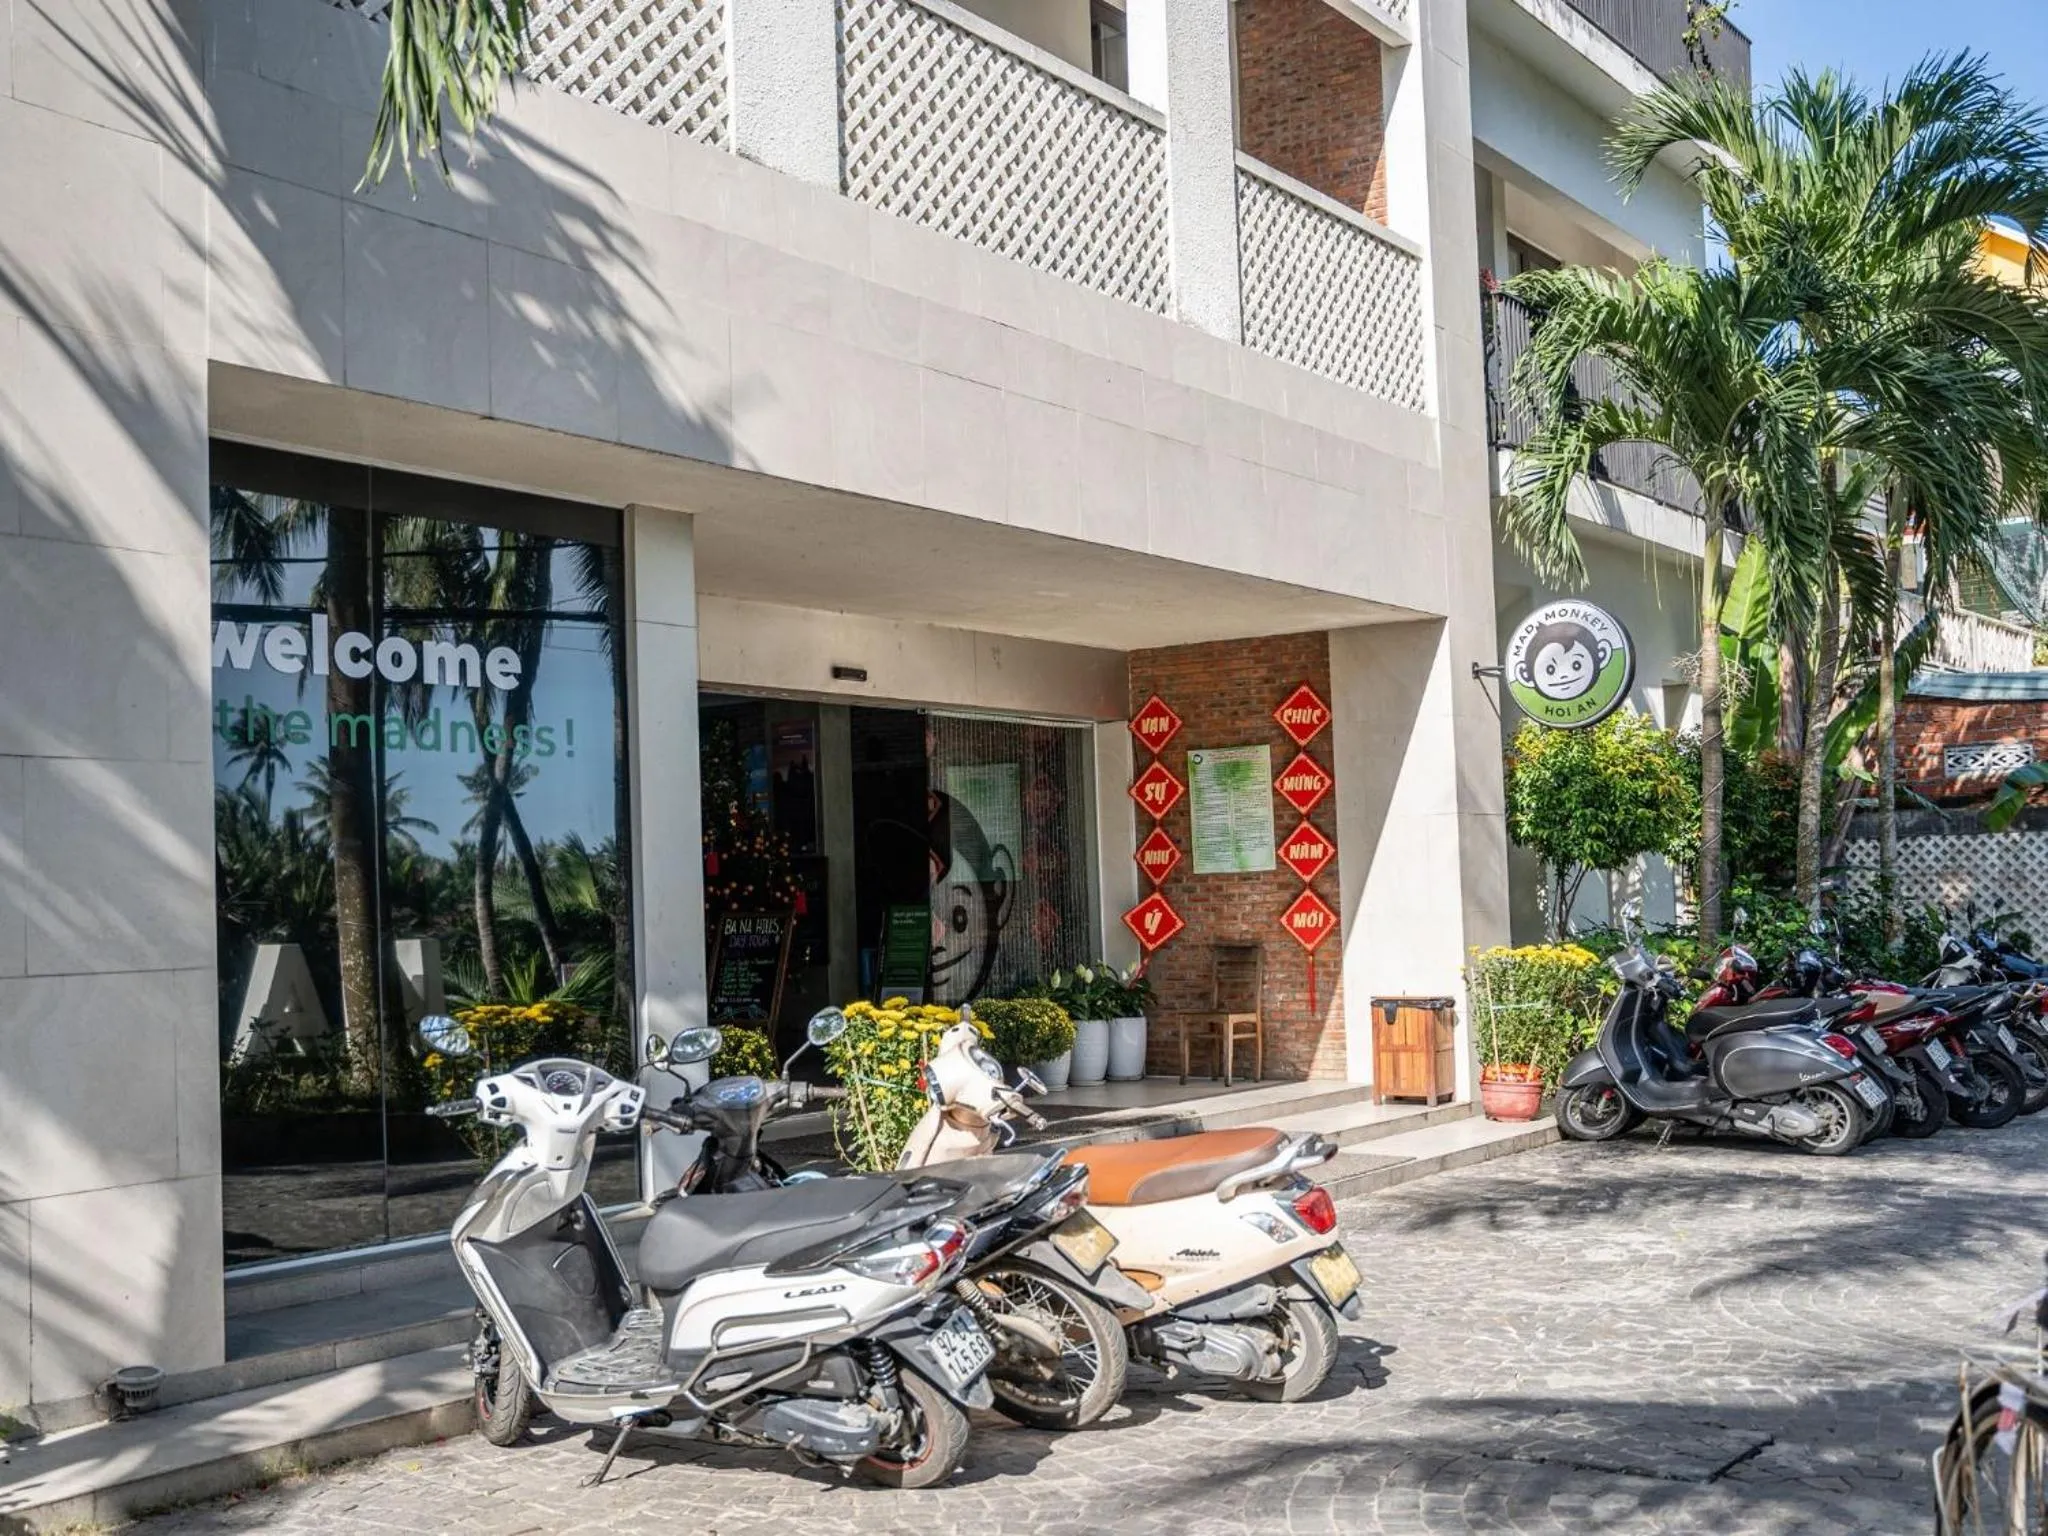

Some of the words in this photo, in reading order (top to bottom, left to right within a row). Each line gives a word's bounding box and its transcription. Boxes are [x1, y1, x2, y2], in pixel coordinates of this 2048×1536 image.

[1513, 624, 1535, 657] MAD
[1544, 608, 1609, 633] MONKEY
[211, 613, 523, 691] welcome
[1282, 704, 1322, 725] CHÚC
[1544, 705, 1571, 718] HOI
[1577, 698, 1597, 714] AN
[214, 694, 314, 746] the
[329, 707, 577, 759] madness!
[1144, 779, 1170, 805] SỰ
[1143, 847, 1173, 866] NHƯ
[1144, 908, 1163, 936] Ý
[783, 1284, 847, 1299] LEAD
